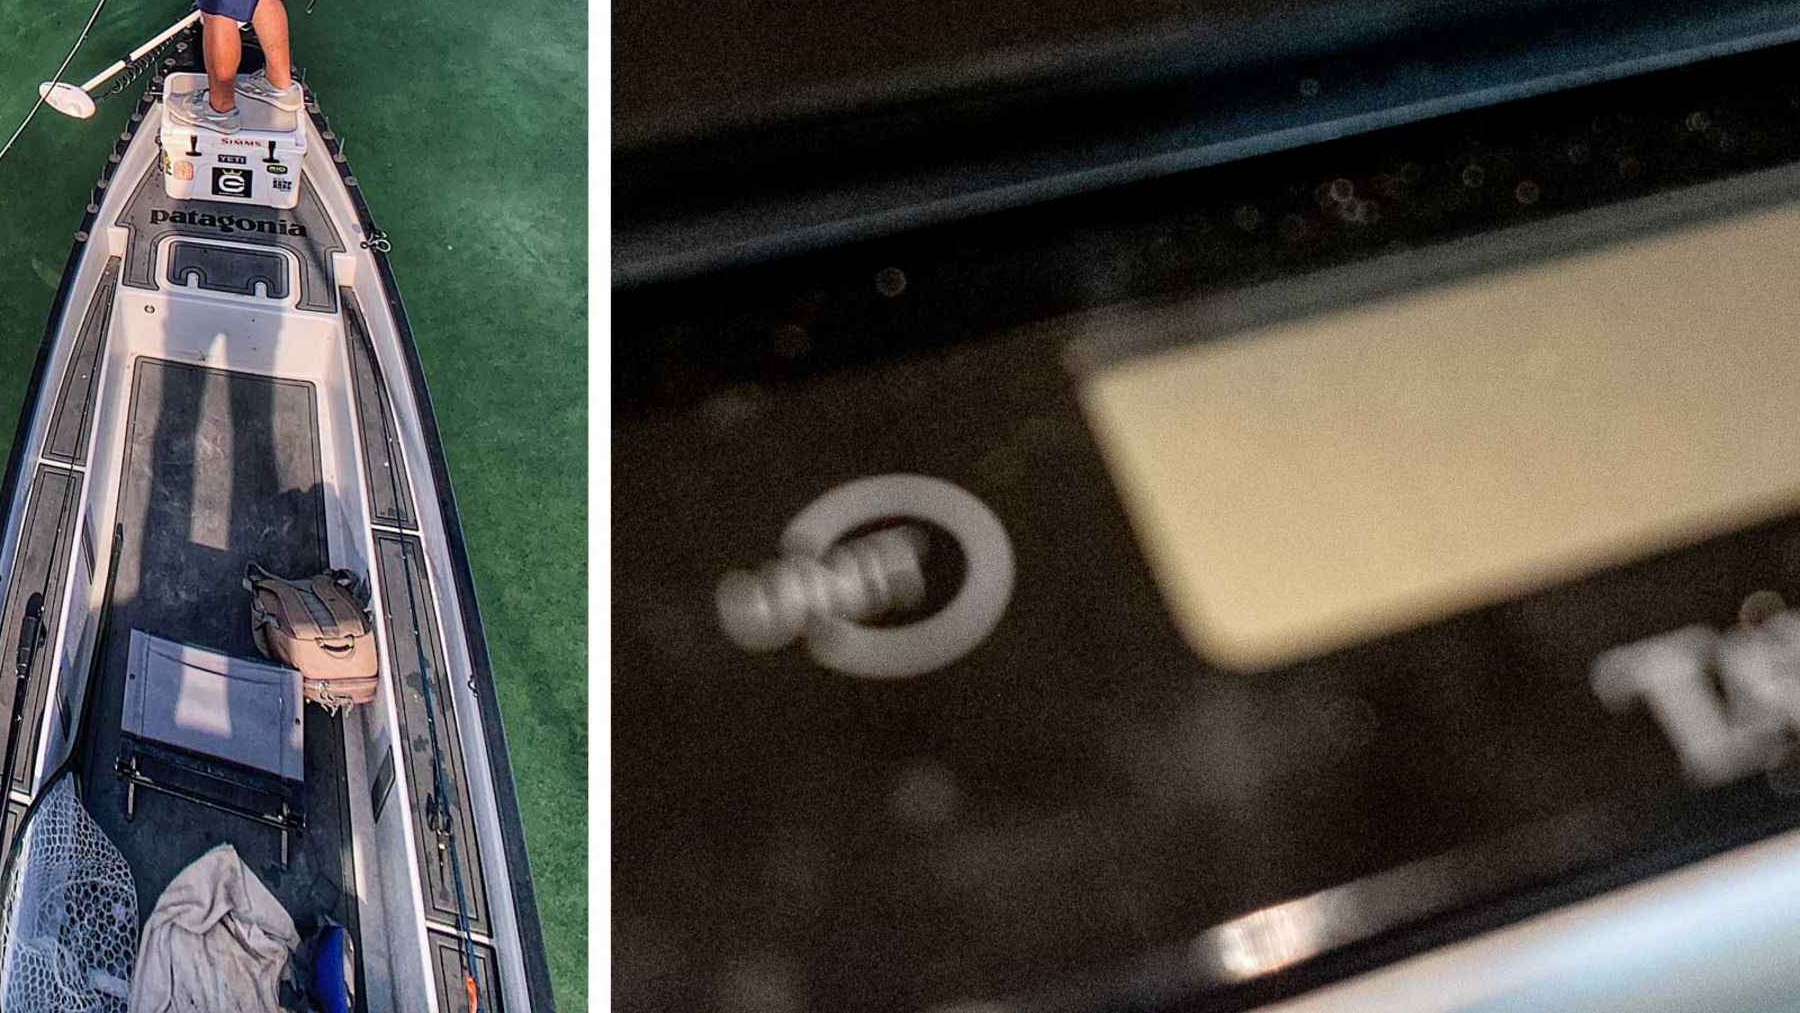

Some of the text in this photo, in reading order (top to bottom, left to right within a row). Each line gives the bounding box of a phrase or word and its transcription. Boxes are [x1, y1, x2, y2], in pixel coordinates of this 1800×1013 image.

[221, 137, 262, 148] SIMMS
[219, 154, 246, 163] YETI
[150, 209, 308, 237] patagonia
